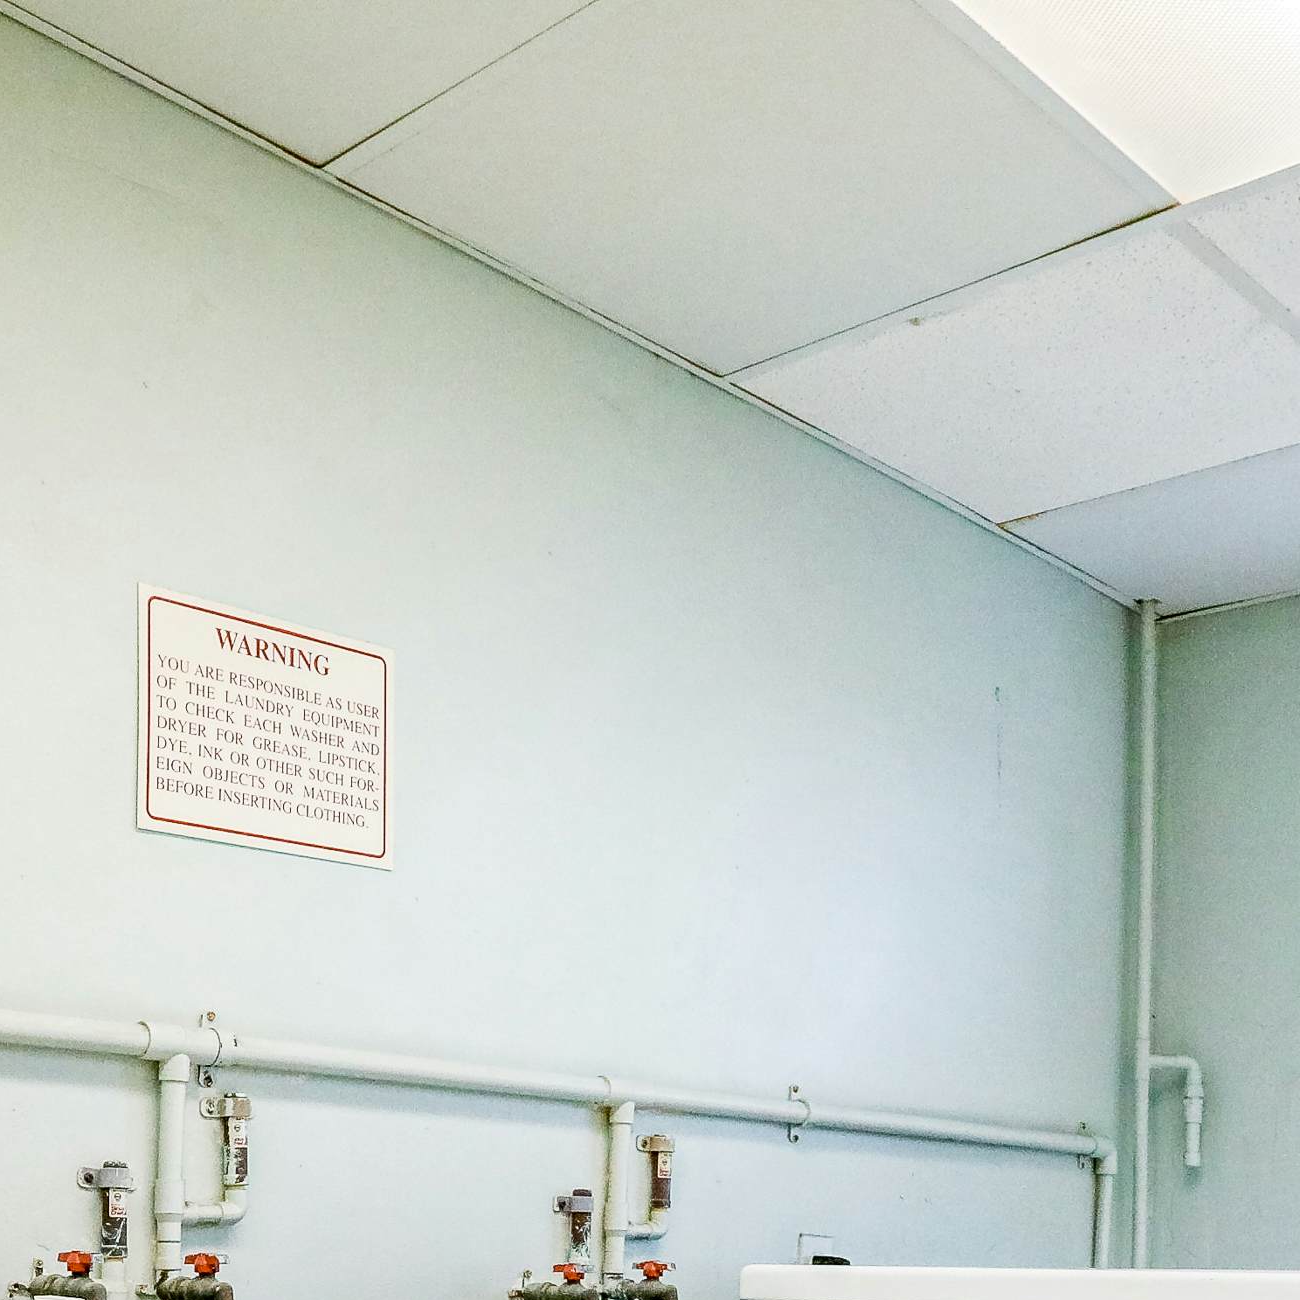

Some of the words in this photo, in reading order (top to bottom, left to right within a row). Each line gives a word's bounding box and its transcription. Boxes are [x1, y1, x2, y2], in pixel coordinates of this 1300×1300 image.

[215, 627, 329, 676] WARNING
[156, 674, 177, 690] OF
[186, 681, 215, 700] THE
[225, 690, 294, 717] LAUNDRY
[303, 708, 379, 737] EQUIPMENT
[158, 654, 190, 673] YOU
[194, 664, 224, 682] ARE
[229, 672, 322, 705] RESPONSIBLE
[326, 697, 342, 710] AS
[347, 700, 379, 719] USER
[156, 694, 176, 711] TO
[185, 701, 234, 724] CHECK
[244, 714, 282, 734] EACH
[290, 724, 344, 748] WASHER
[352, 740, 380, 756] AND
[157, 715, 206, 737] DRYER
[216, 728, 243, 745] FOR
[156, 756, 192, 775] EIGN
[202, 765, 265, 789] OBJECTS
[274, 780, 293, 795] OR
[303, 785, 379, 812] MATERIALS
[198, 744, 223, 761] INK
[230, 751, 249, 767] OR
[256, 757, 302, 778] OTHER
[308, 767, 344, 786] SUCH
[350, 776, 379, 792] FOR-
[156, 776, 214, 800] BEFORE
[218, 788, 292, 814] INSERTING
[296, 803, 369, 829] CLOTHING.
